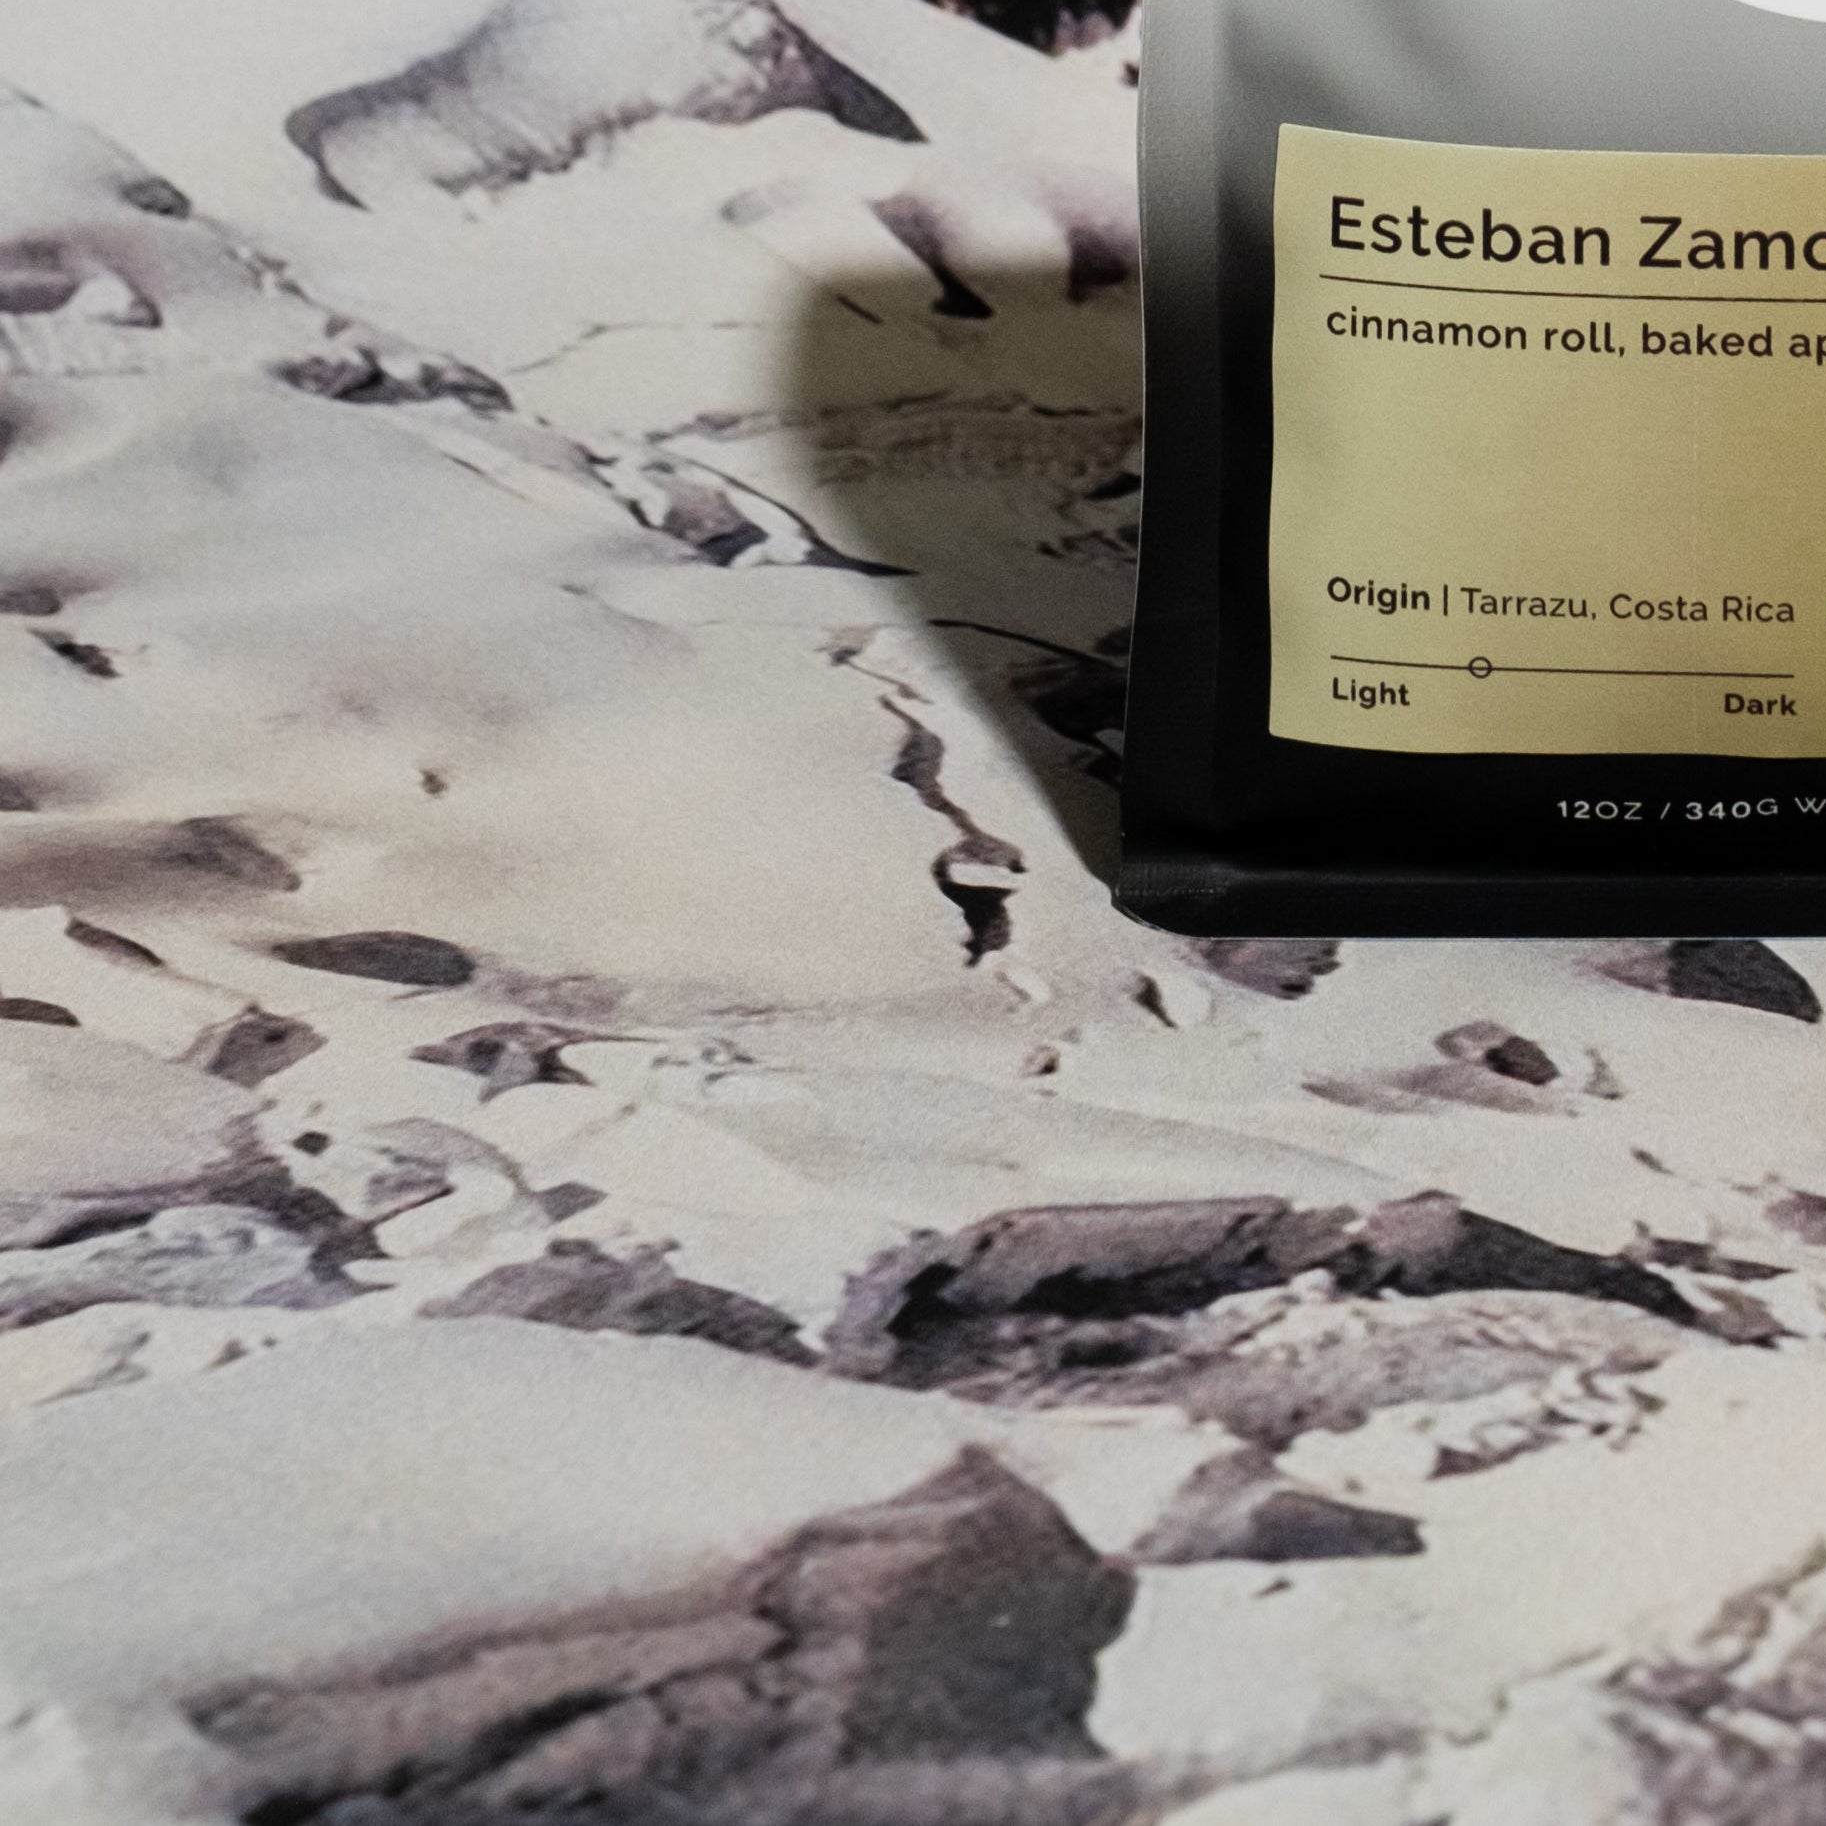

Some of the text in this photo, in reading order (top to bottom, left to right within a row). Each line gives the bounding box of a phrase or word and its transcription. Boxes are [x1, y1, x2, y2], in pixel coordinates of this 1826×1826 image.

[1330, 195, 1611, 267] Esteban
[1326, 305, 1527, 351] cinnamon
[1544, 320, 1626, 358] roll,
[1641, 322, 1774, 358] baked
[1326, 576, 1431, 616] Origin
[1460, 586, 1597, 621] Tarrazu,
[1609, 592, 1709, 623] Costa
[1722, 595, 1795, 624] Rica
[1332, 676, 1411, 710] Light
[1723, 692, 1797, 717] Dark
[1557, 799, 1643, 821] 12OZ
[1685, 797, 1779, 821] 340G
